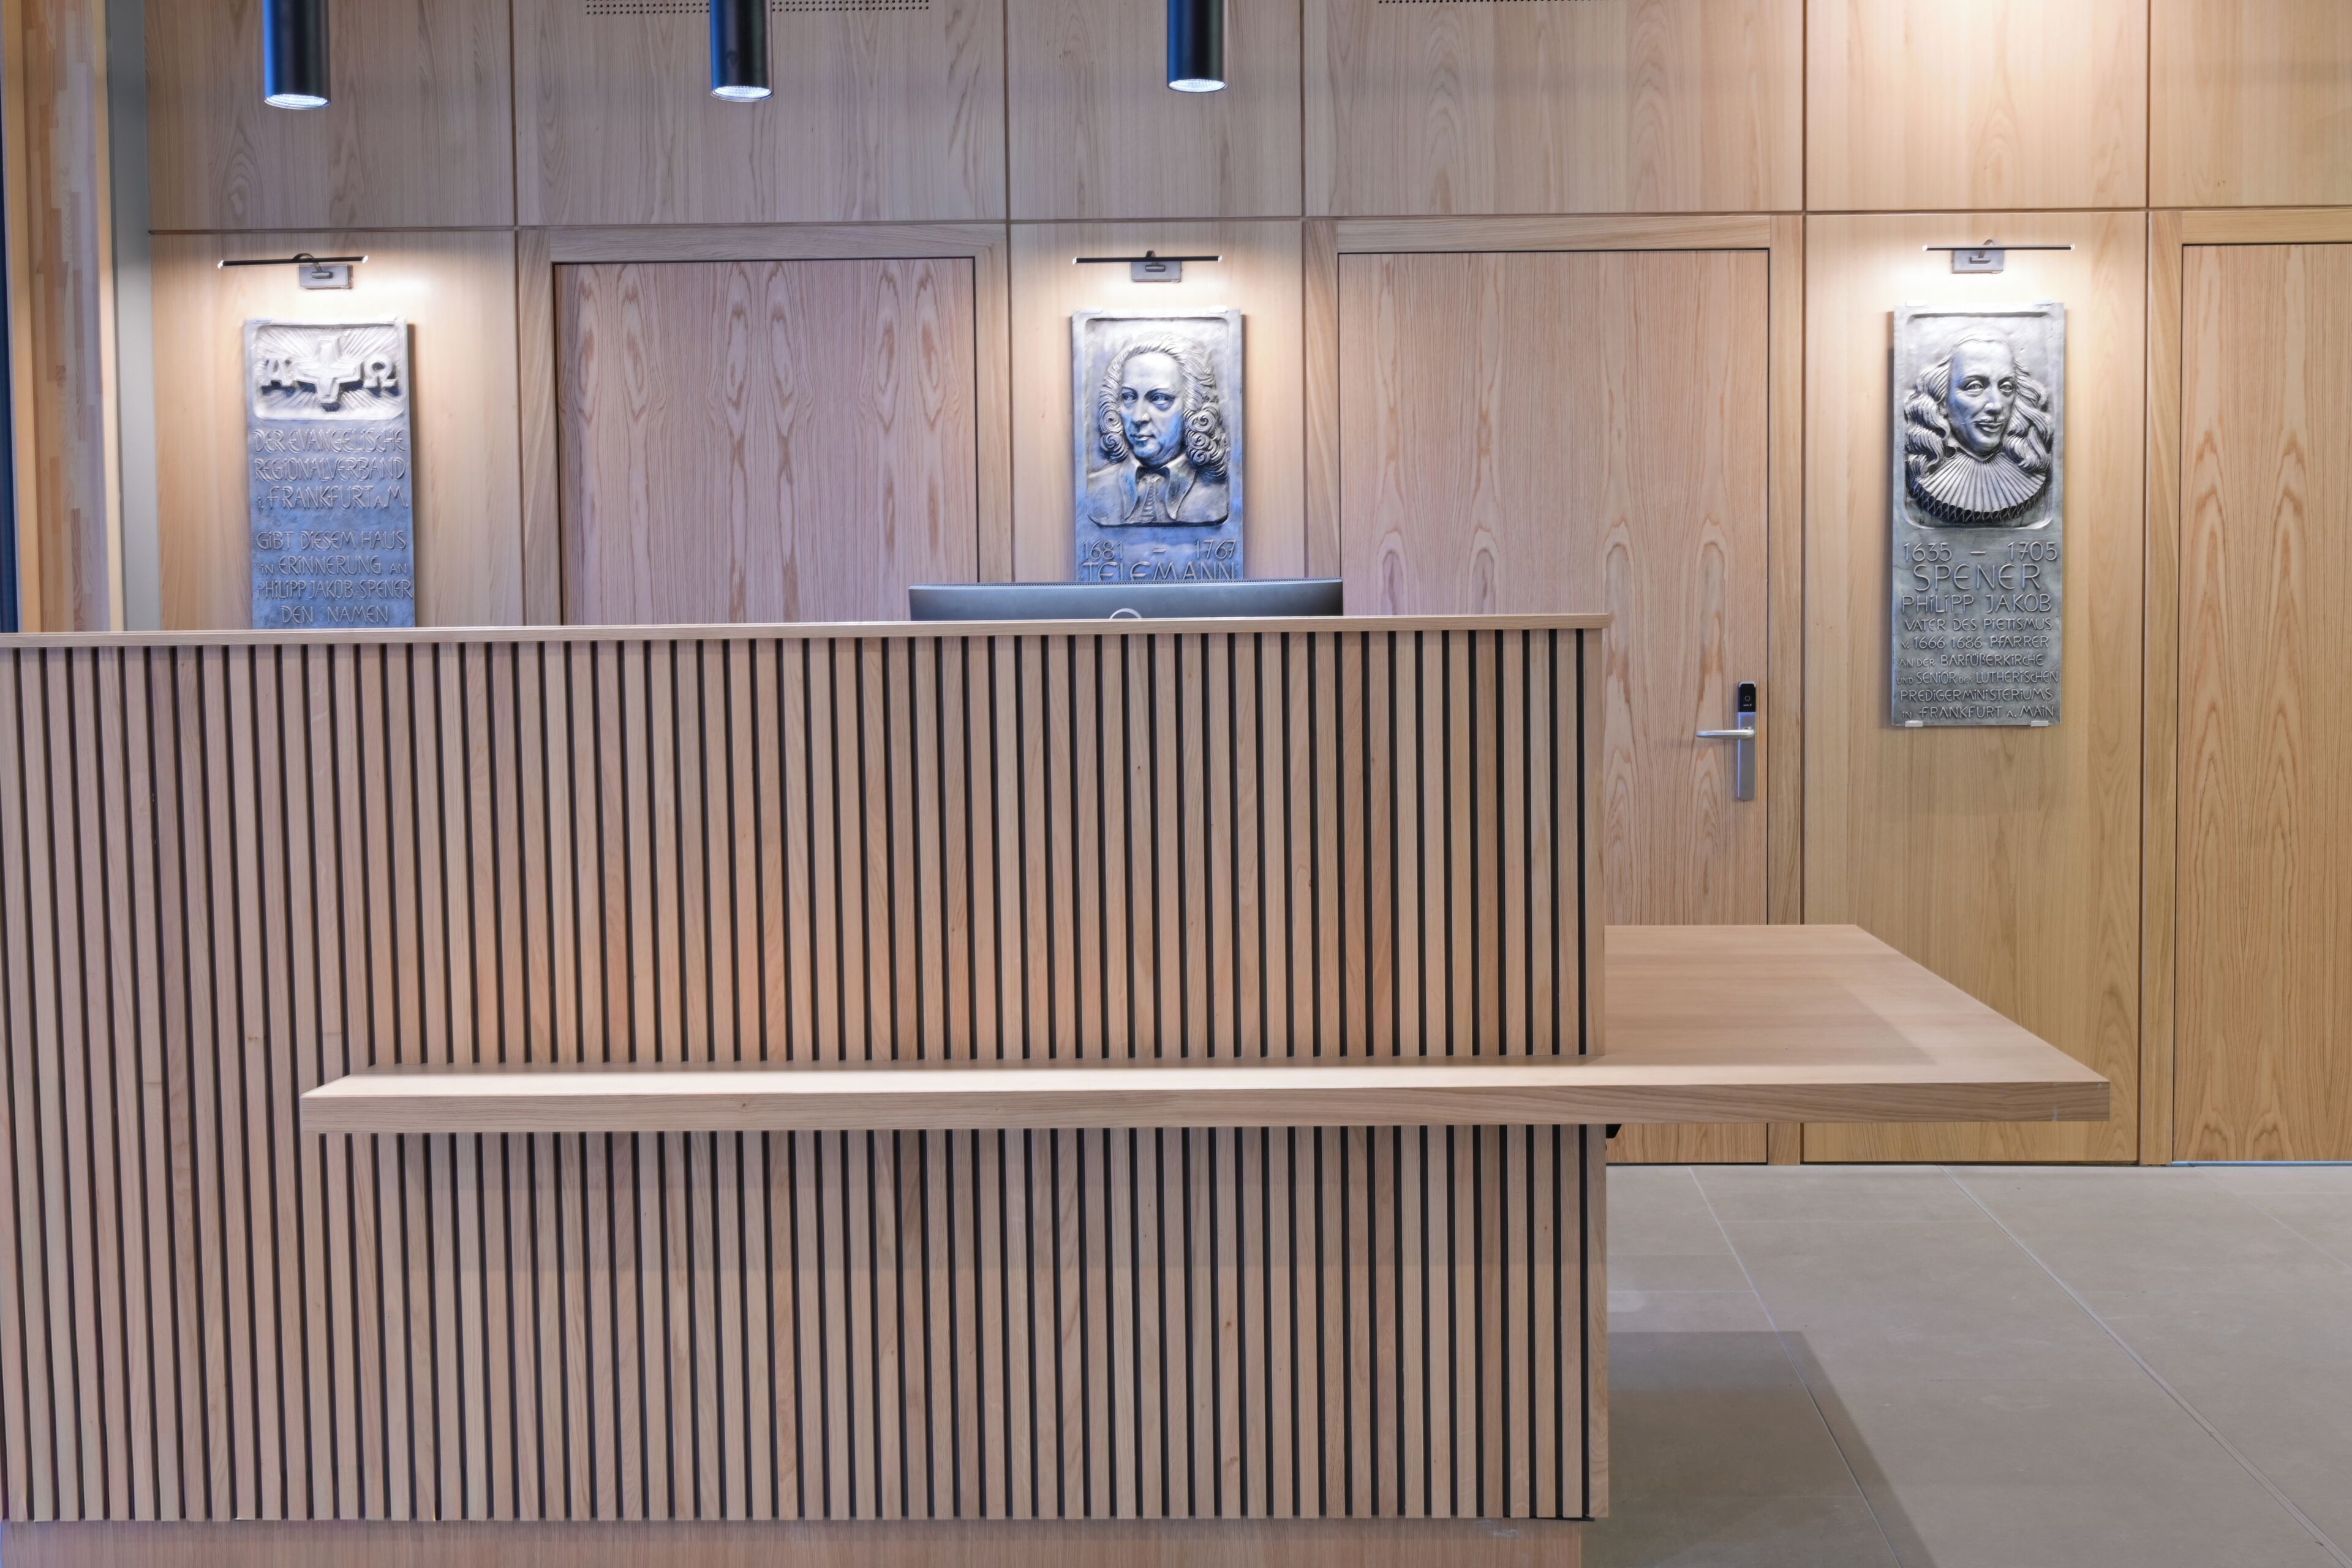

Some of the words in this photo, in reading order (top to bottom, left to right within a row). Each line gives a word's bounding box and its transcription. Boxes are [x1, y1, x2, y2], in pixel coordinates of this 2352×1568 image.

[253, 428, 285, 453] DER
[254, 457, 407, 482] REGIONALVERBAND
[266, 486, 374, 510] FRANKFURT
[361, 530, 407, 550] HAUS
[1082, 539, 1123, 560] 1681
[1194, 538, 1237, 559] 1767
[1904, 542, 1952, 562] 1635
[2008, 541, 2058, 561] 1705
[1913, 563, 2041, 592] SPENER
[307, 579, 353, 600] JAKOB
[358, 579, 413, 600] SPENER
[1985, 593, 2051, 613] JAKOB
[281, 605, 314, 624] DEN
[326, 605, 389, 624] NAMEN
[1905, 617, 1946, 631] VATER
[1953, 618, 1977, 631] DES
[1913, 636, 1946, 649] 1666
[1951, 636, 1983, 649] 1686
[1899, 657, 1913, 666] AN
[1917, 658, 1936, 667] DER
[1897, 676, 1914, 685] UND
[1959, 676, 1973, 684] DES
[1919, 706, 2002, 719] FRANKFURT
